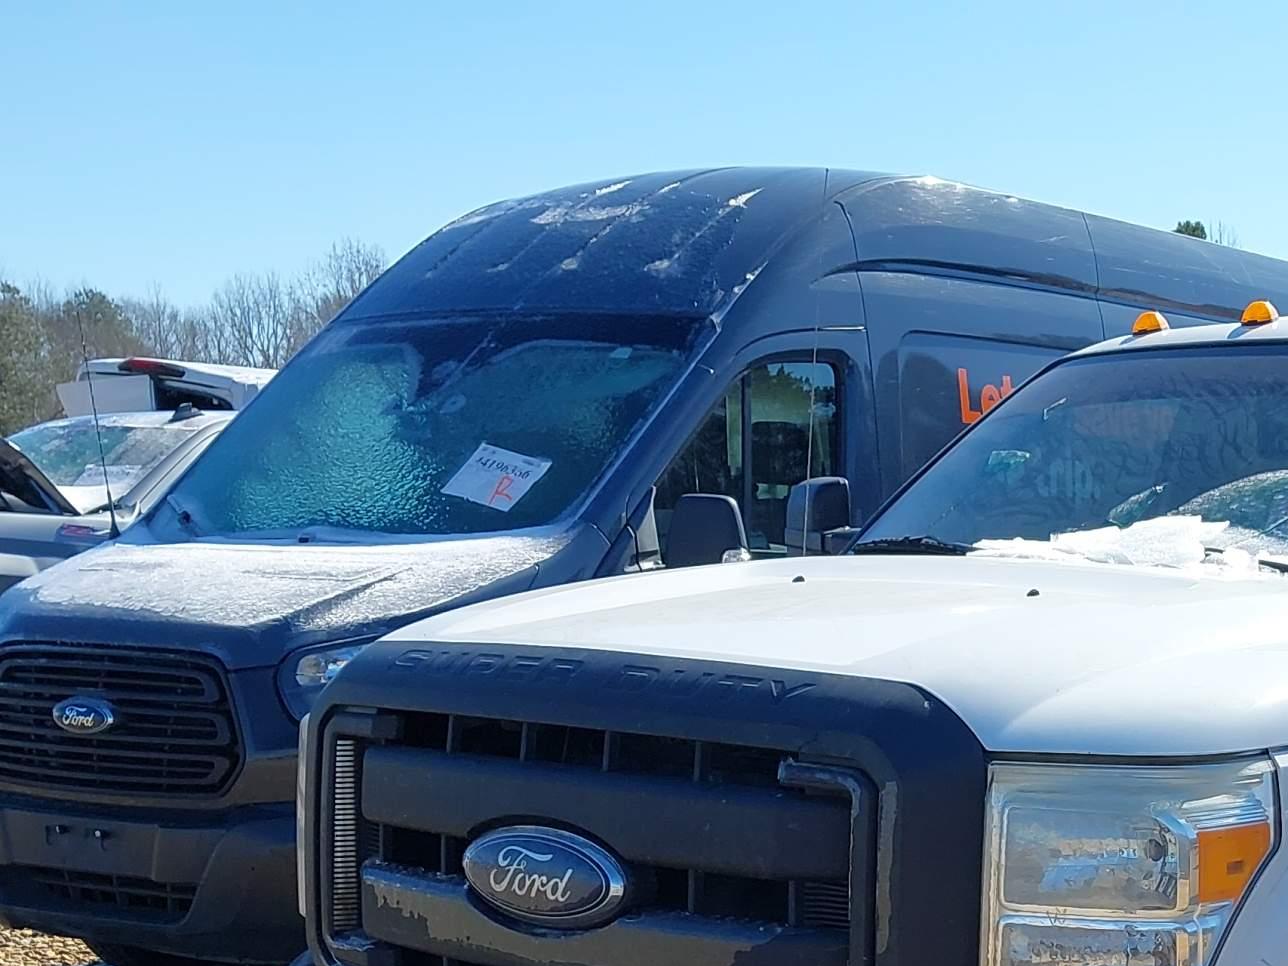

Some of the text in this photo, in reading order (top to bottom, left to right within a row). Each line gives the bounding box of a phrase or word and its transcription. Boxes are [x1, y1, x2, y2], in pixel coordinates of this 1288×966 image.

[388, 648, 817, 704] SUPER DUTY
[62, 705, 95, 727] Ford
[489, 845, 573, 902] Ford
